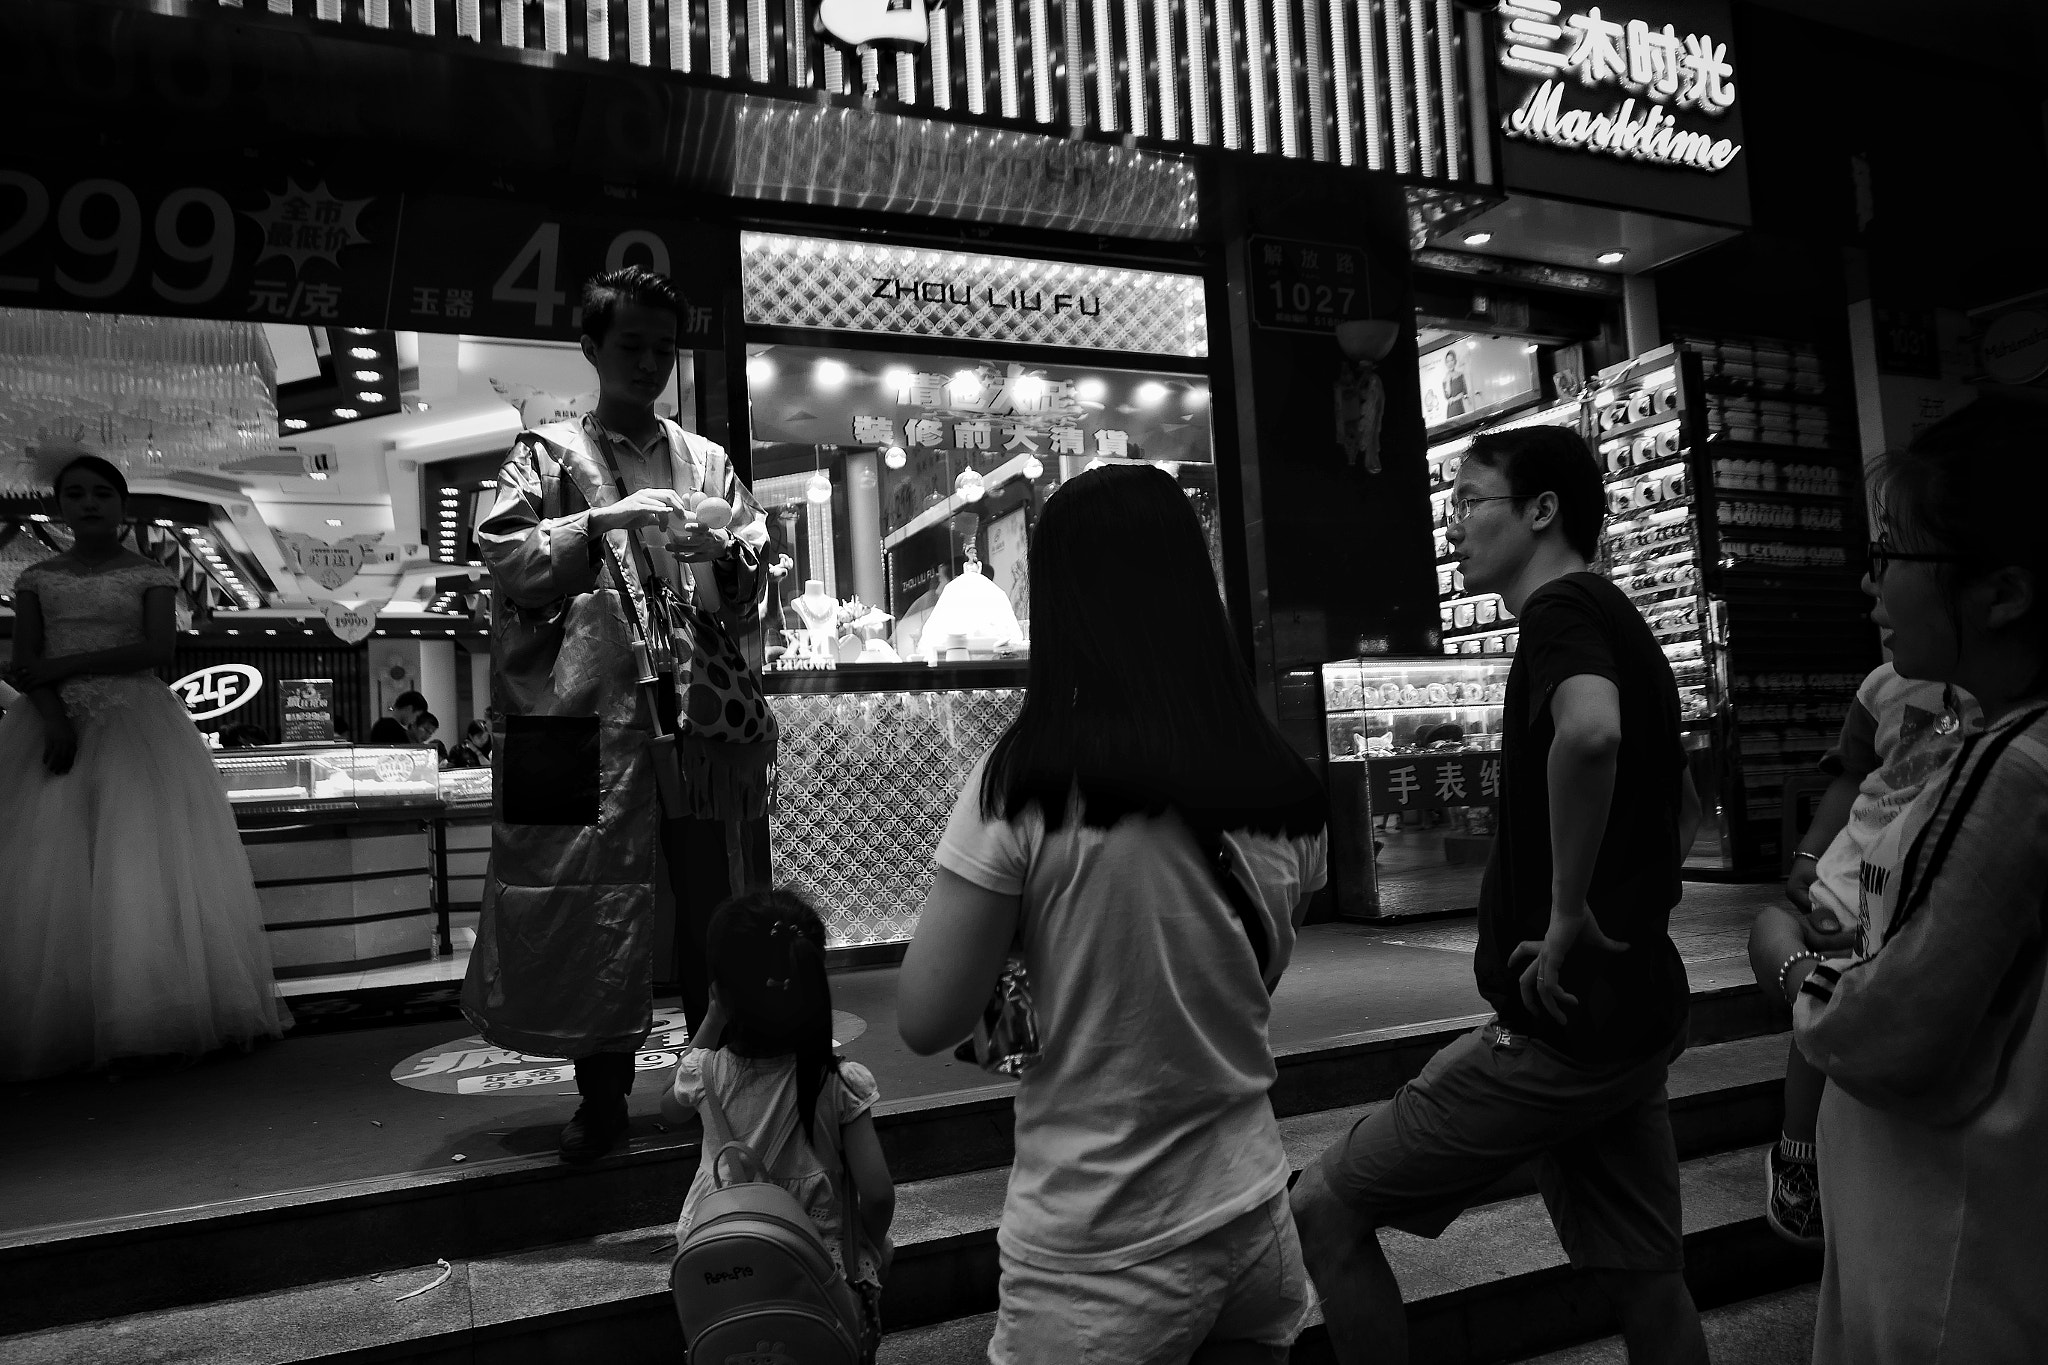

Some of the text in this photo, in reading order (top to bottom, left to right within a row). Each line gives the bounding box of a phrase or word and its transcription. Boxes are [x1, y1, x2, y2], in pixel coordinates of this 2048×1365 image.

[1503, 0, 1736, 108] 三木时光
[1507, 79, 1742, 170] Marktime
[281, 199, 344, 225] 全市
[0, 169, 237, 304] 299
[267, 221, 350, 252] 最低价
[1264, 243, 1355, 274] 解放路
[247, 279, 343, 319] 元/克
[410, 286, 474, 319] 玉器
[872, 277, 1099, 316] ZHOU LIU FU
[1269, 280, 1356, 315] 1027
